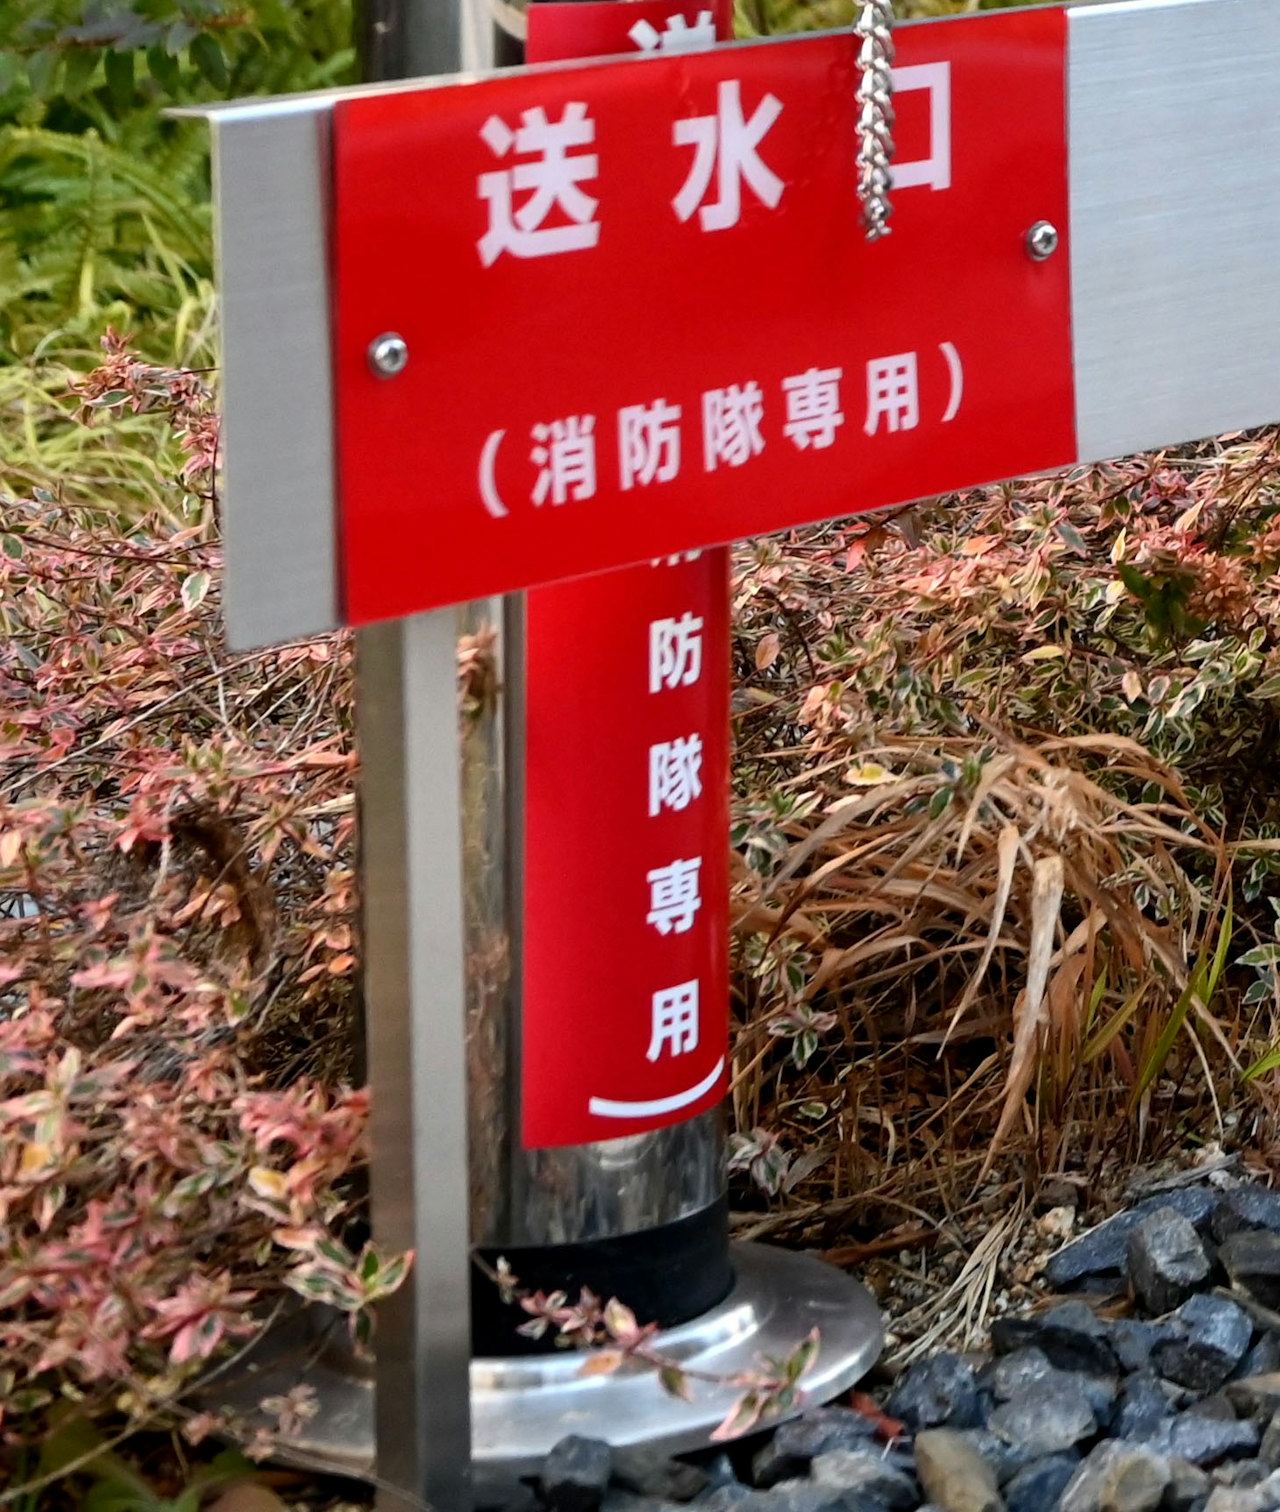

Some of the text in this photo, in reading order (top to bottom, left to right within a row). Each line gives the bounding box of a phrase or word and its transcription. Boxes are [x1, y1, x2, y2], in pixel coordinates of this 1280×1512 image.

[477, 60, 951, 269] 送水口
[478, 341, 963, 517] （消防隊専用）
[589, 549, 725, 1118] 防隊専用）
